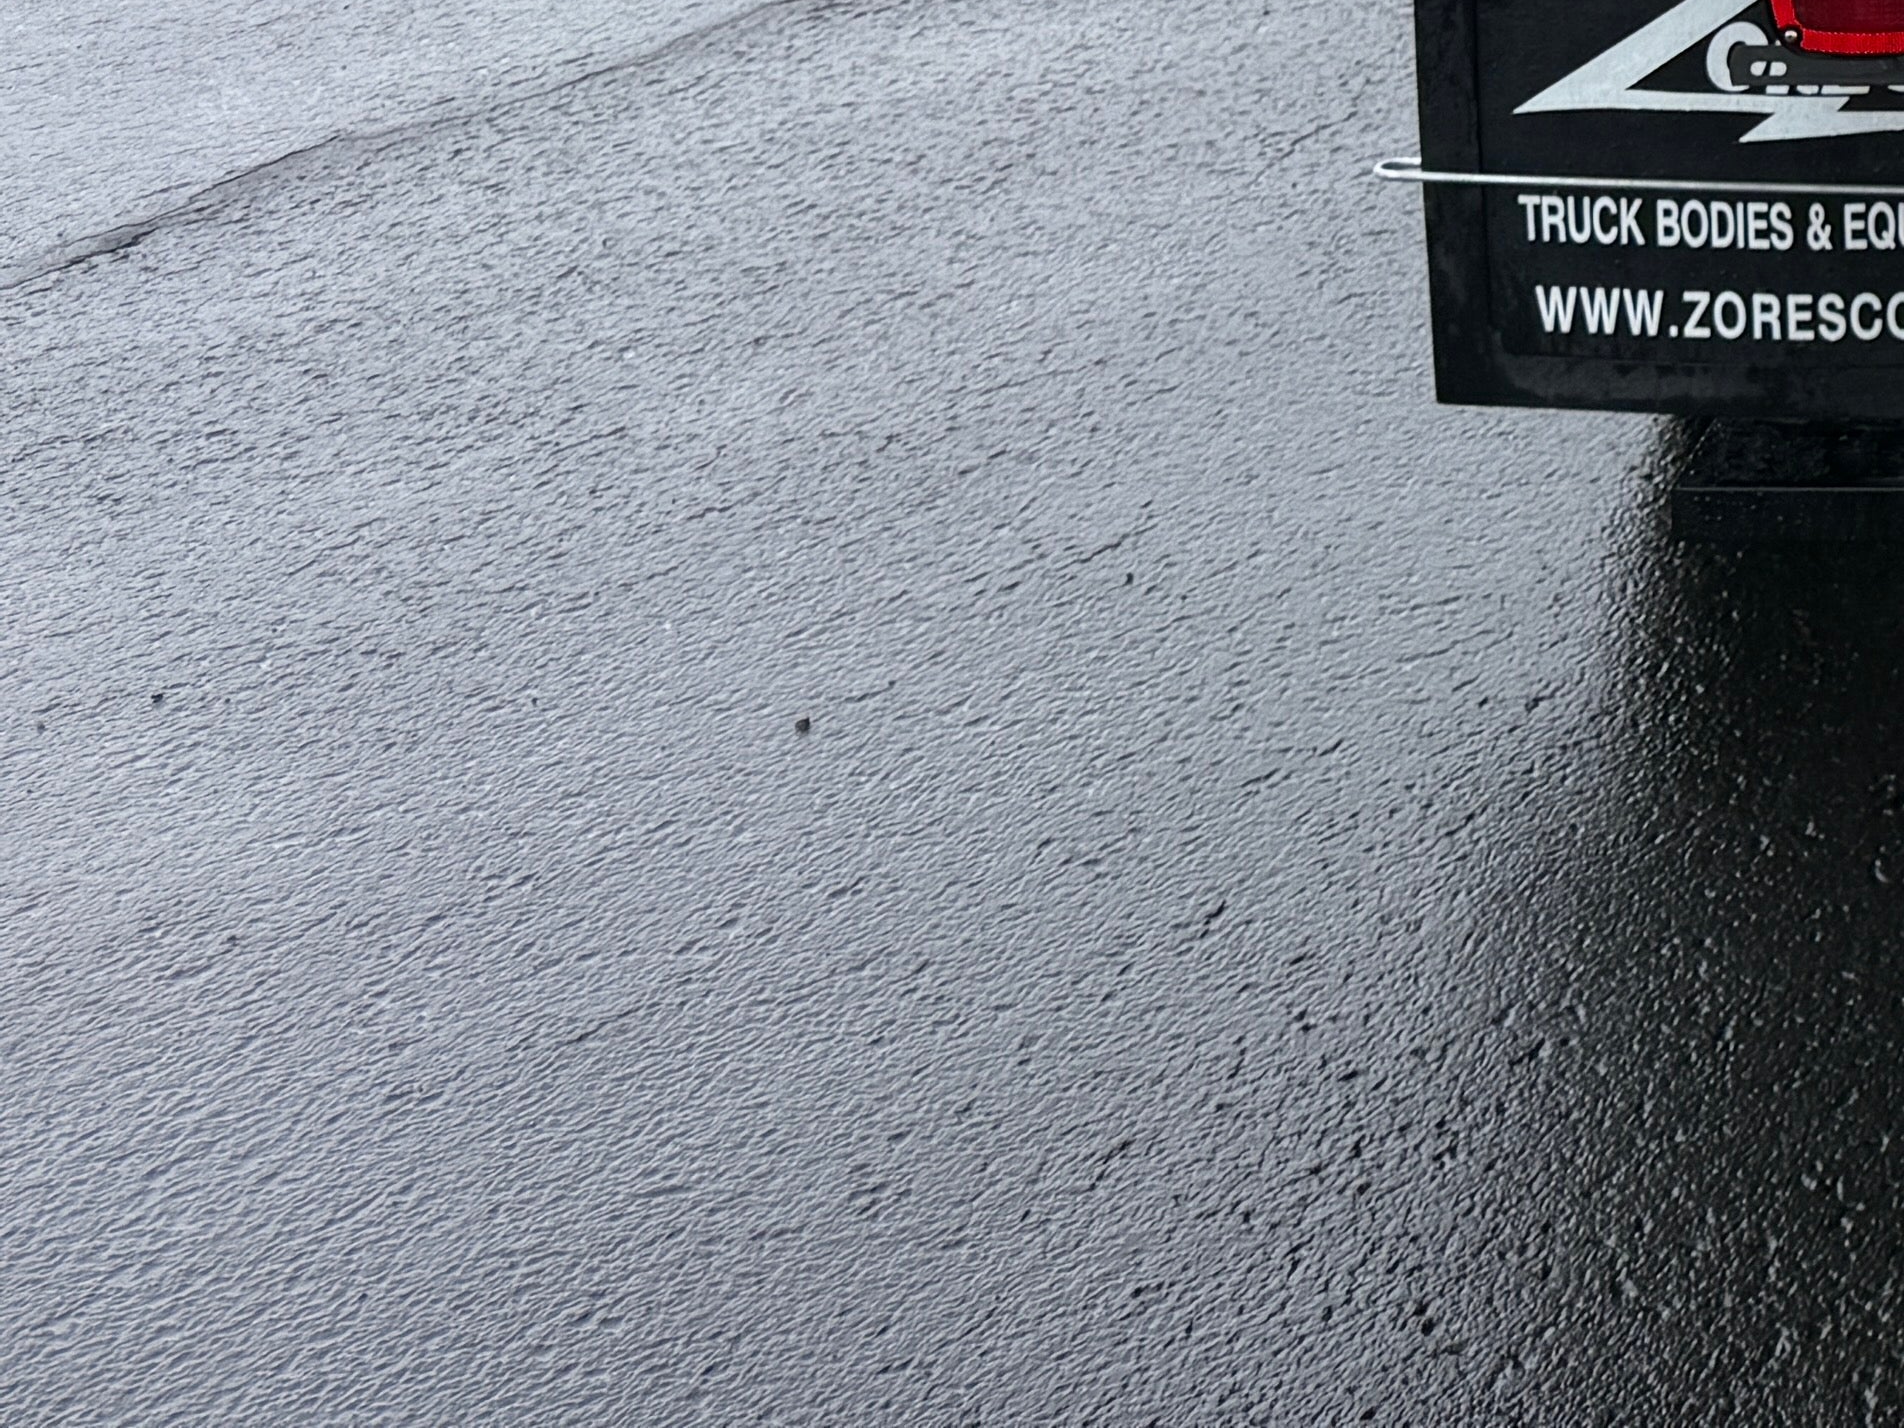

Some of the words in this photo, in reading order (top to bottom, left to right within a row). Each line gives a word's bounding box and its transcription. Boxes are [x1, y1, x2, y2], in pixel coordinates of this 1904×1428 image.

[1518, 195, 1645, 245] TRUCK
[1657, 200, 1793, 250] BODIES
[1807, 203, 1832, 250] &
